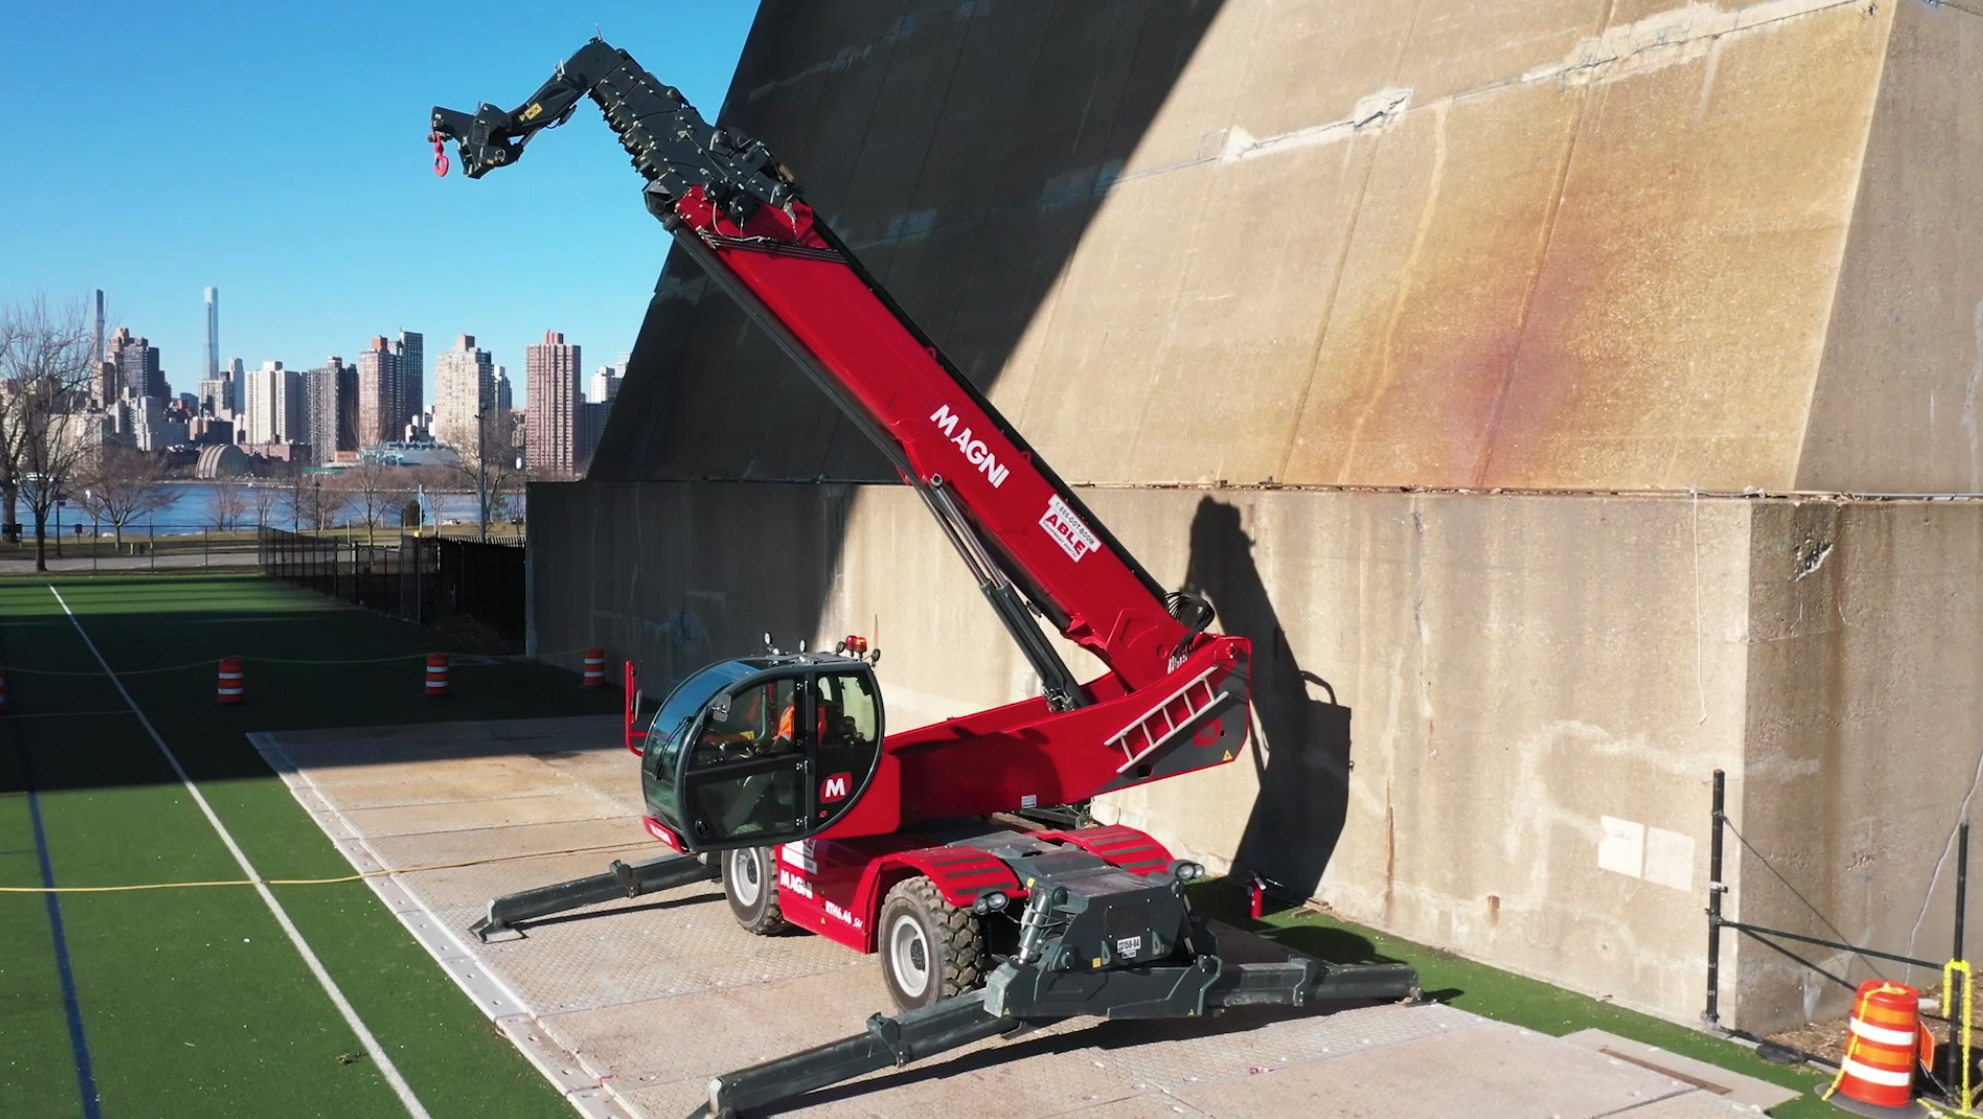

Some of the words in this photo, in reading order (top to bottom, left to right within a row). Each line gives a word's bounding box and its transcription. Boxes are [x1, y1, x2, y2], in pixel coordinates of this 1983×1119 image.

[929, 404, 1010, 489] MAGNI
[1045, 513, 1086, 555] ABLE
[825, 777, 846, 797] M
[780, 869, 813, 900] MAGNI
